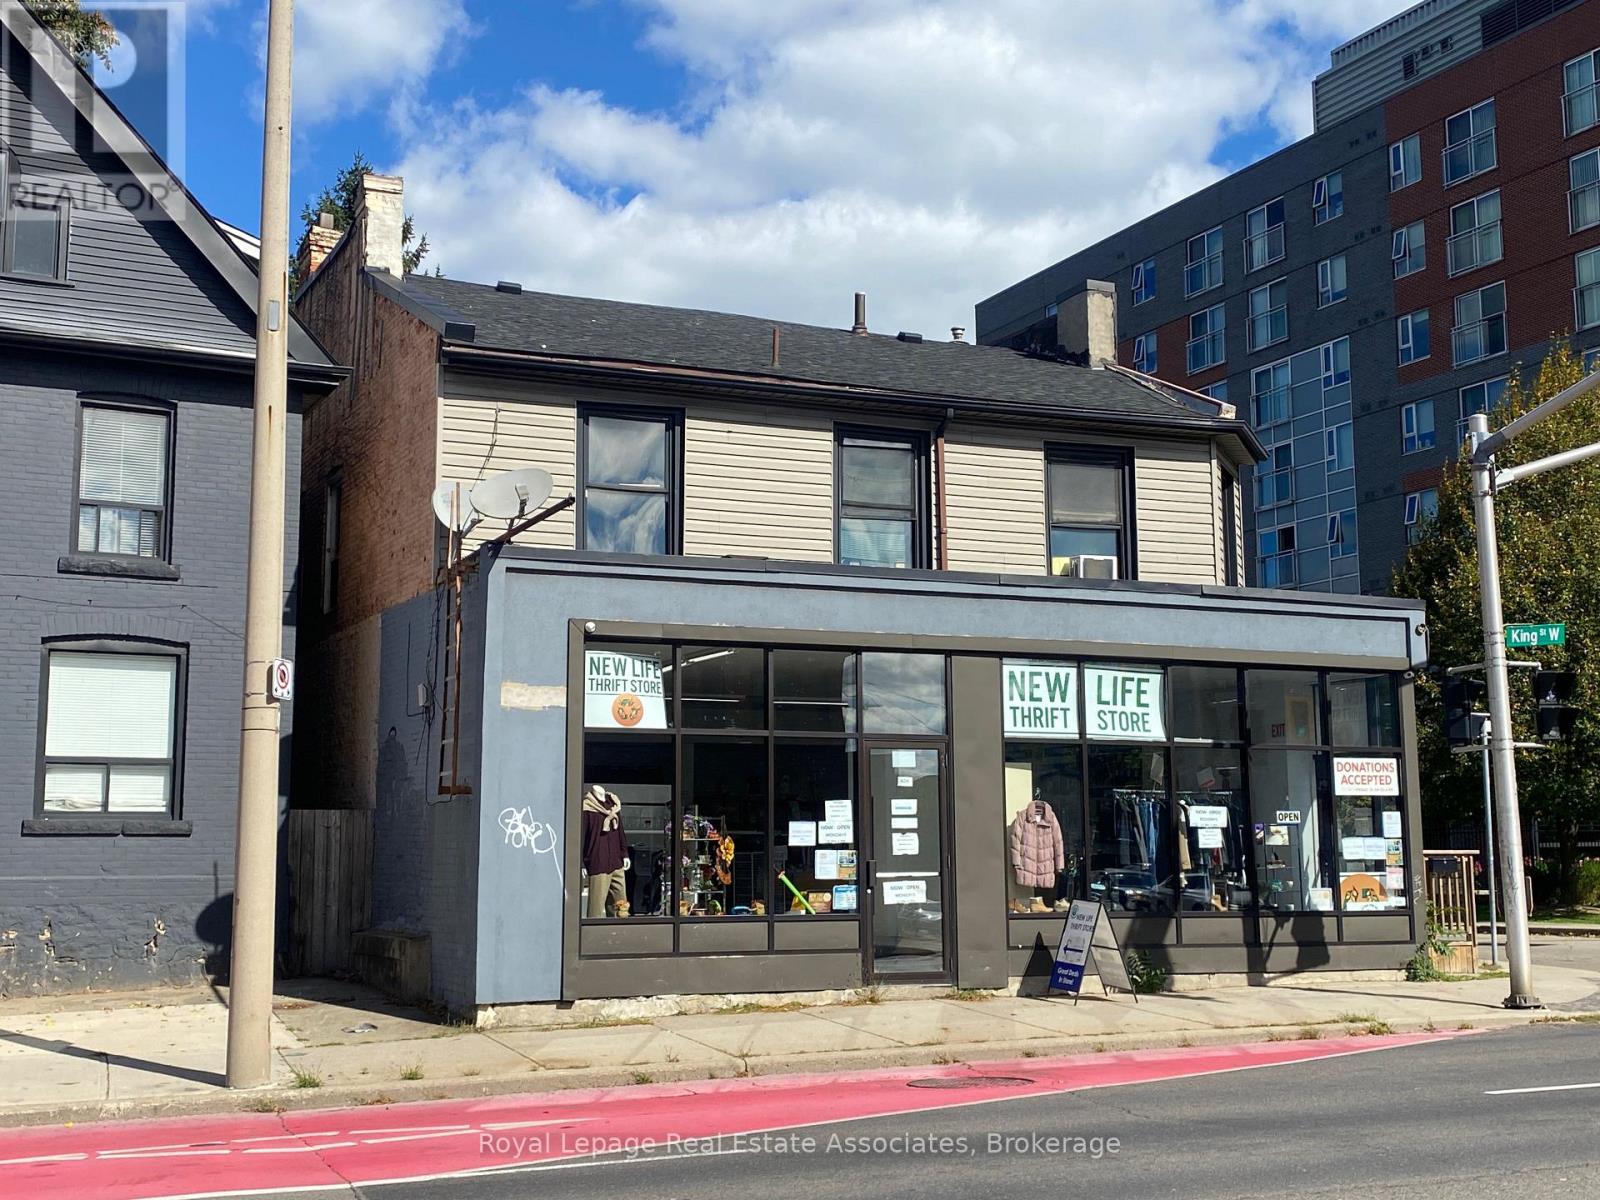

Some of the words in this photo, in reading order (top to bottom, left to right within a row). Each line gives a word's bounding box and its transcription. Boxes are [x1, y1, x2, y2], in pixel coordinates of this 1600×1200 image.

[1511, 629, 1538, 645] King
[1548, 627, 1560, 641] W
[589, 656, 627, 676] NEW
[632, 659, 660, 679] LIFE
[588, 677, 628, 692] THRIFT
[630, 679, 662, 695] STORE
[1008, 670, 1070, 703] NEW
[1096, 674, 1150, 708] LIFE
[1009, 706, 1070, 728] THRIFT
[1097, 709, 1152, 732] STORE
[1336, 761, 1395, 773] DONATIONS
[1340, 774, 1392, 785] ACCEPTED
[1278, 812, 1299, 821] OPEN
